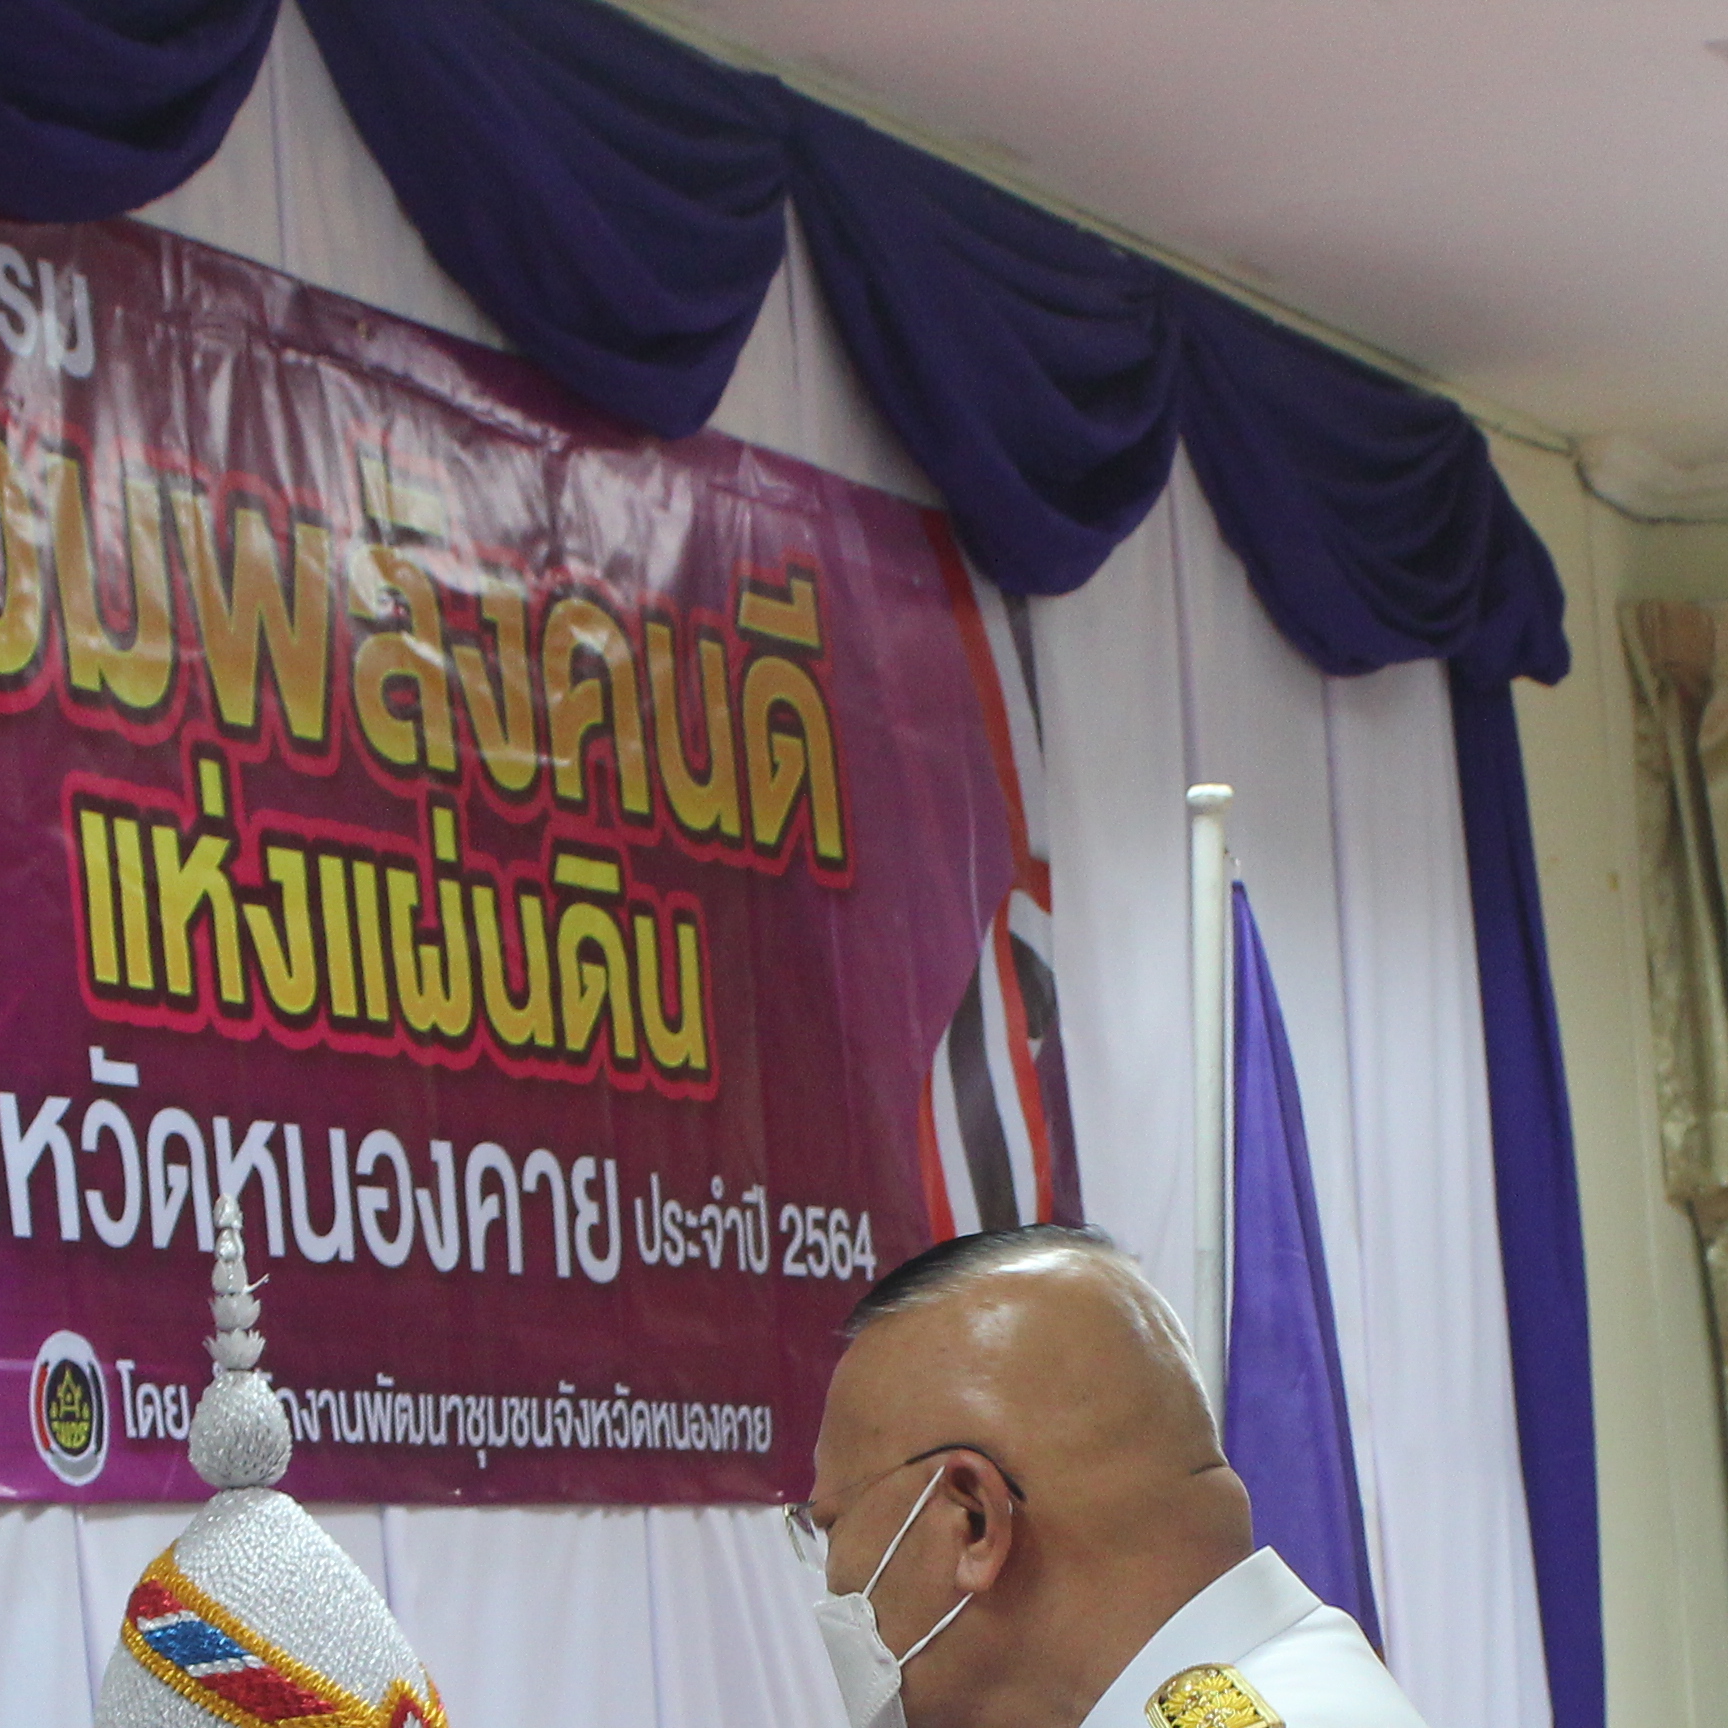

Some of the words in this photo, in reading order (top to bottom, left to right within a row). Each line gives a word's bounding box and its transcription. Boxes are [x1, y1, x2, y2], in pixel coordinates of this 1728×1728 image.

[78, 760, 708, 1073] แห่งแผ่นดิน
[633, 1171, 771, 1275] ประจำปี
[778, 1203, 878, 1282] 2564
[115, 1358, 191, 1441] โดย
